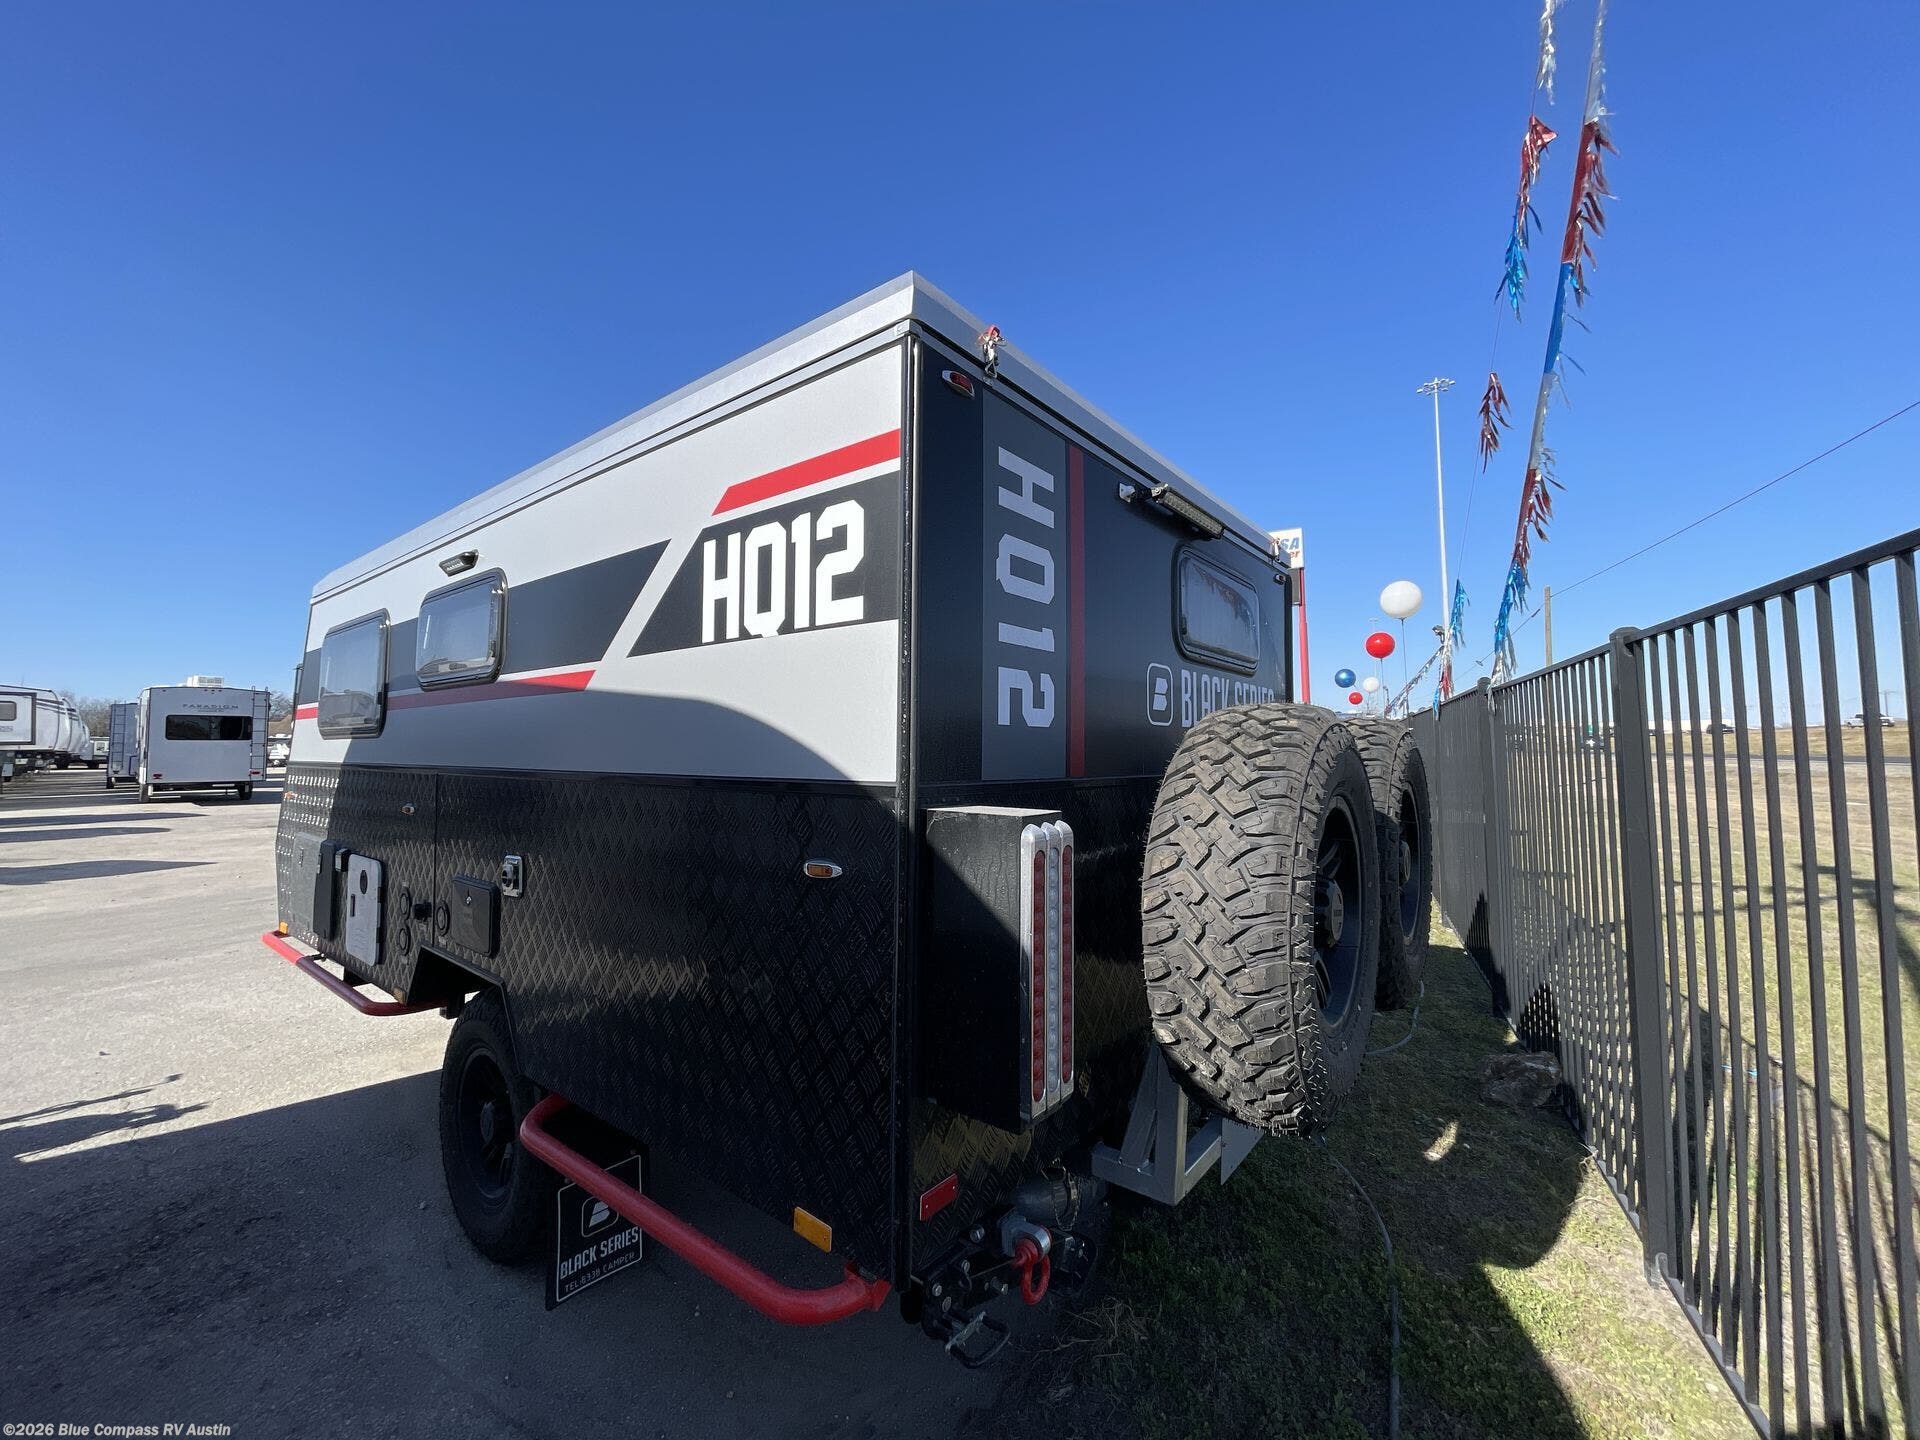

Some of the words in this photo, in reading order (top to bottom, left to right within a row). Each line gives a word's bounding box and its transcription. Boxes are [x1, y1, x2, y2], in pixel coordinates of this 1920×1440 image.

[702, 499, 866, 643] HQ12
[996, 446, 1055, 728] HQ12
[560, 1245, 597, 1280] BLACK
[600, 1226, 639, 1257] SERIES
